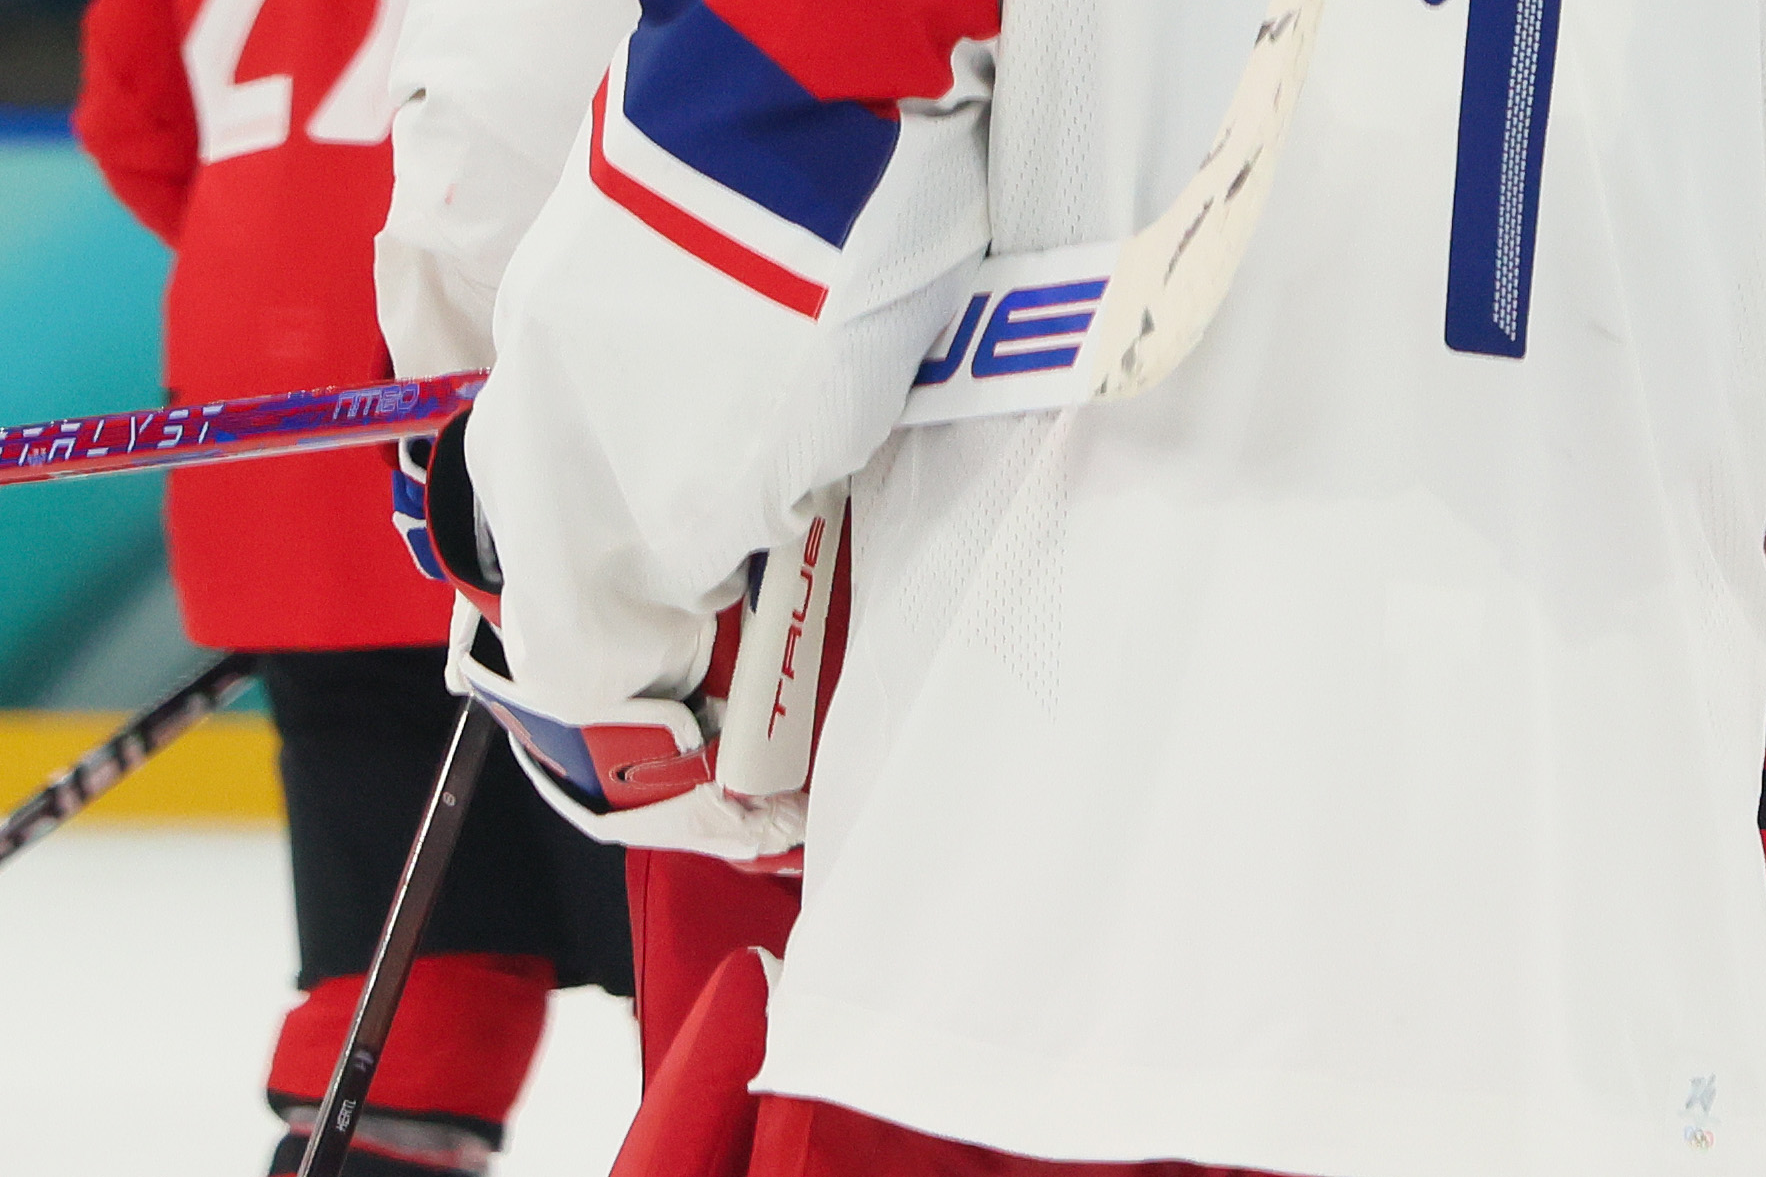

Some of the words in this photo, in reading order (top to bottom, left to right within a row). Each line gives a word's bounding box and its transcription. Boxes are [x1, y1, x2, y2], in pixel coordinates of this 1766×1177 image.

[910, 275, 1112, 388] UE
[0, 402, 225, 468] TALYST
[767, 515, 826, 741] TRUE
